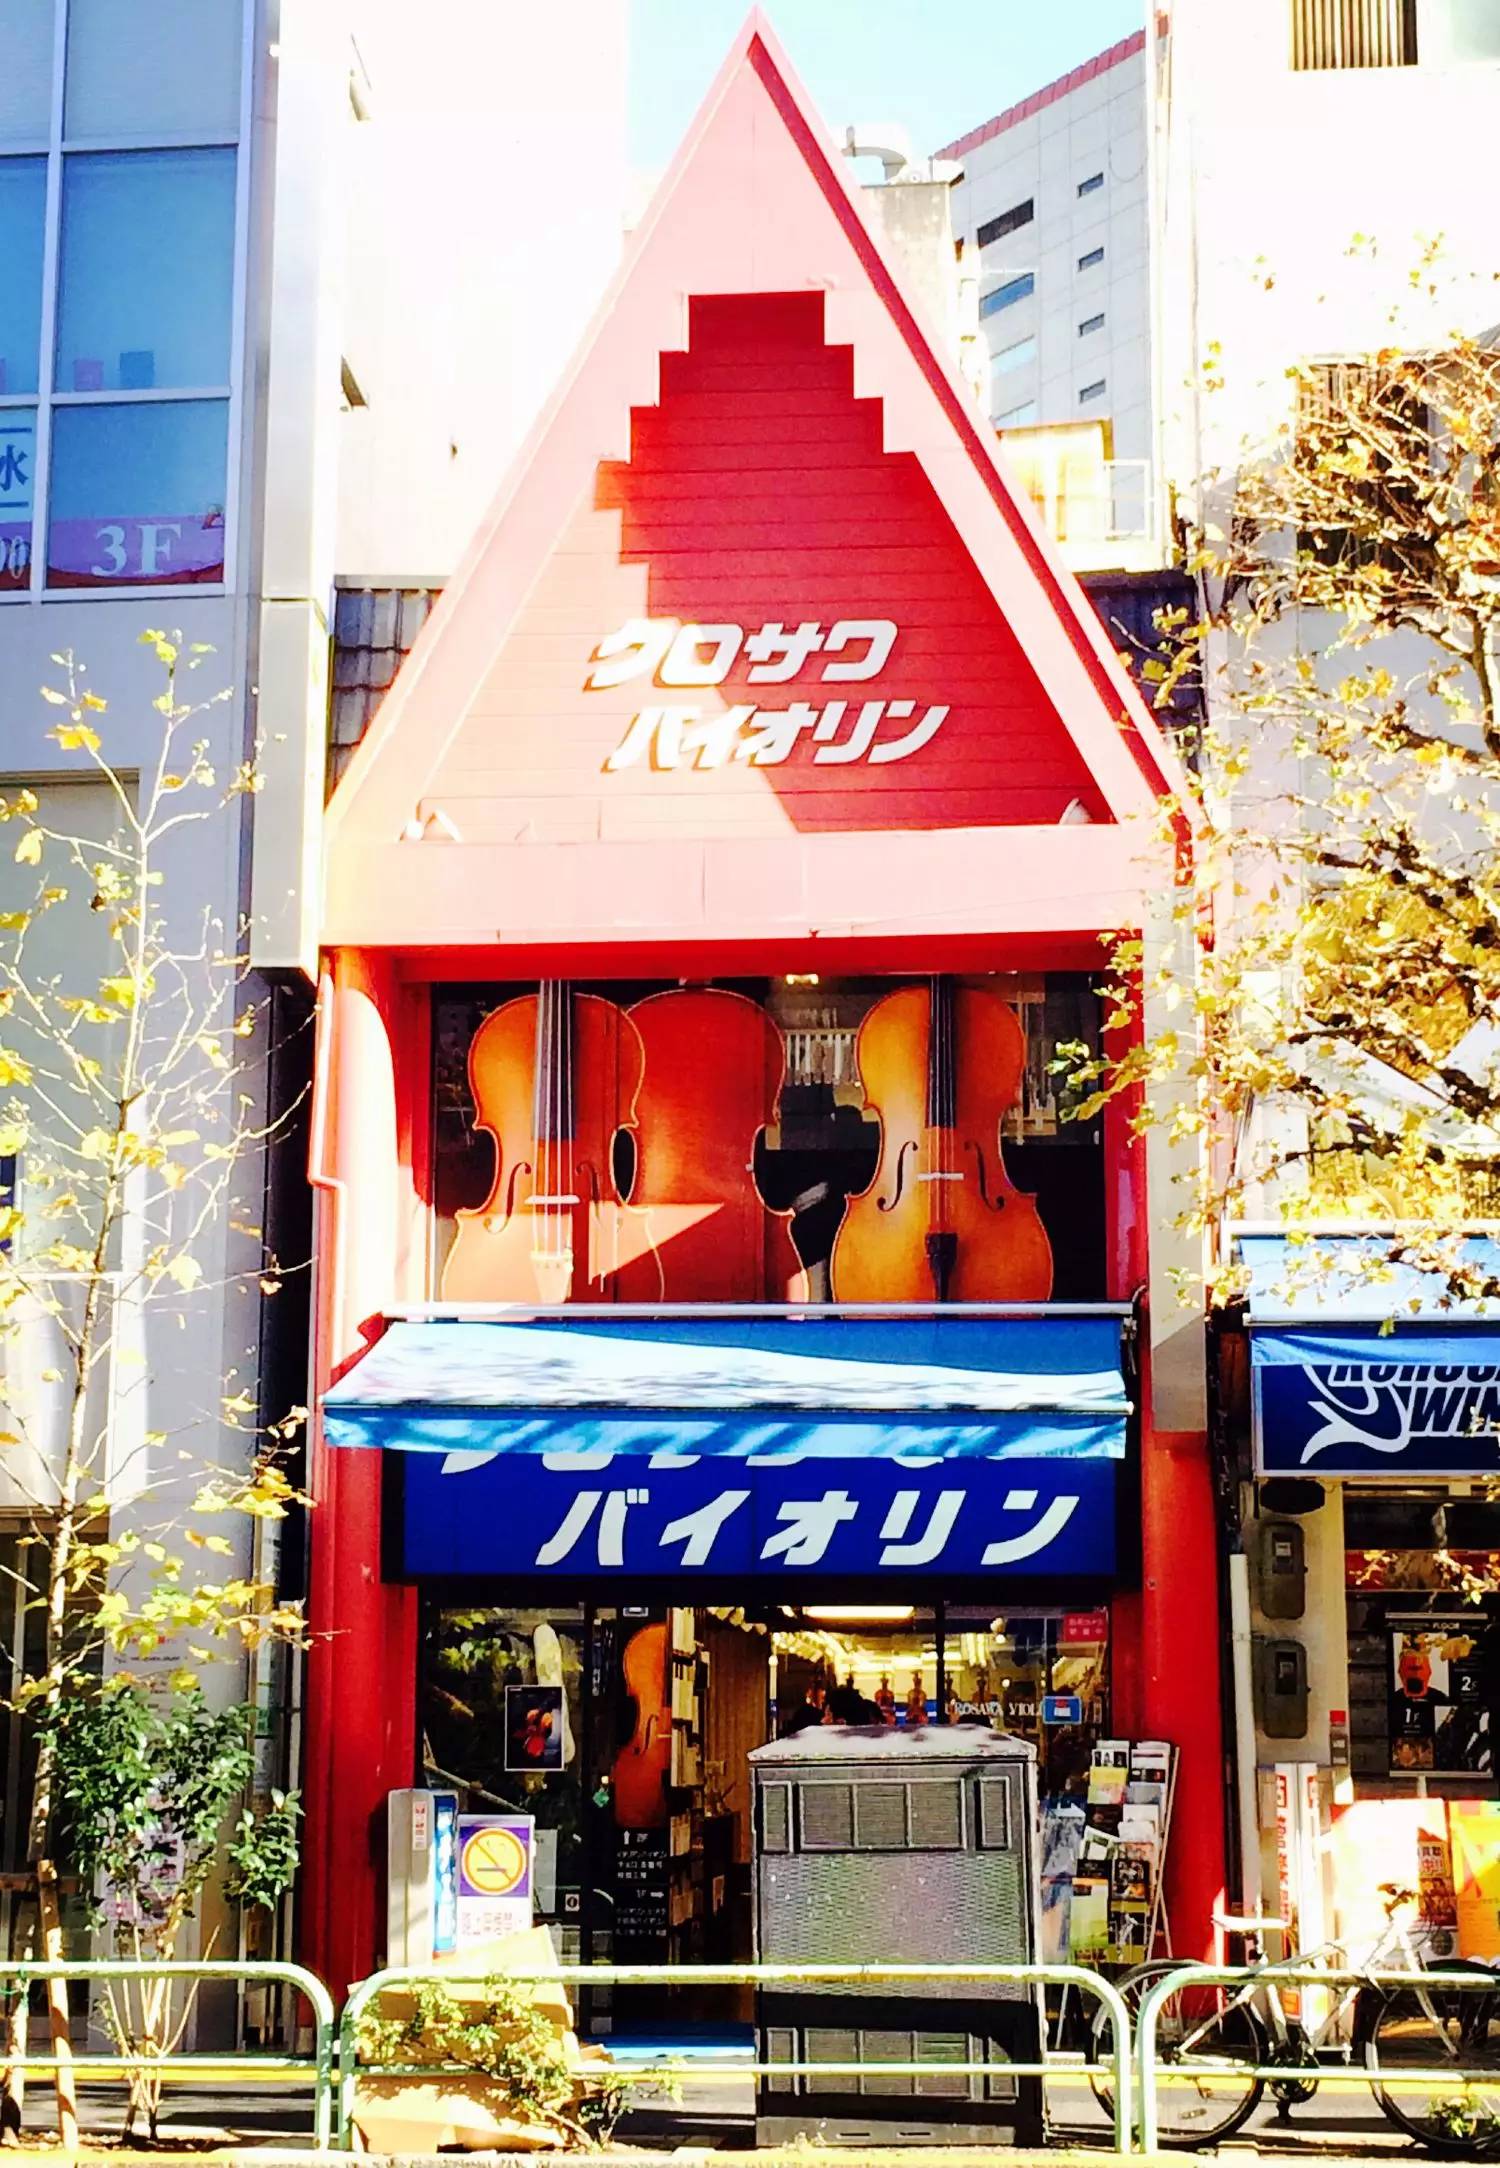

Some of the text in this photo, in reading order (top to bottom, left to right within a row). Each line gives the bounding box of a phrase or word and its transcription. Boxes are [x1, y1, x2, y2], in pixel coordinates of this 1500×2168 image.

[90, 523, 182, 578] 3F
[583, 618, 898, 692] クロサワ
[535, 1489, 1081, 1567] バイオリン
